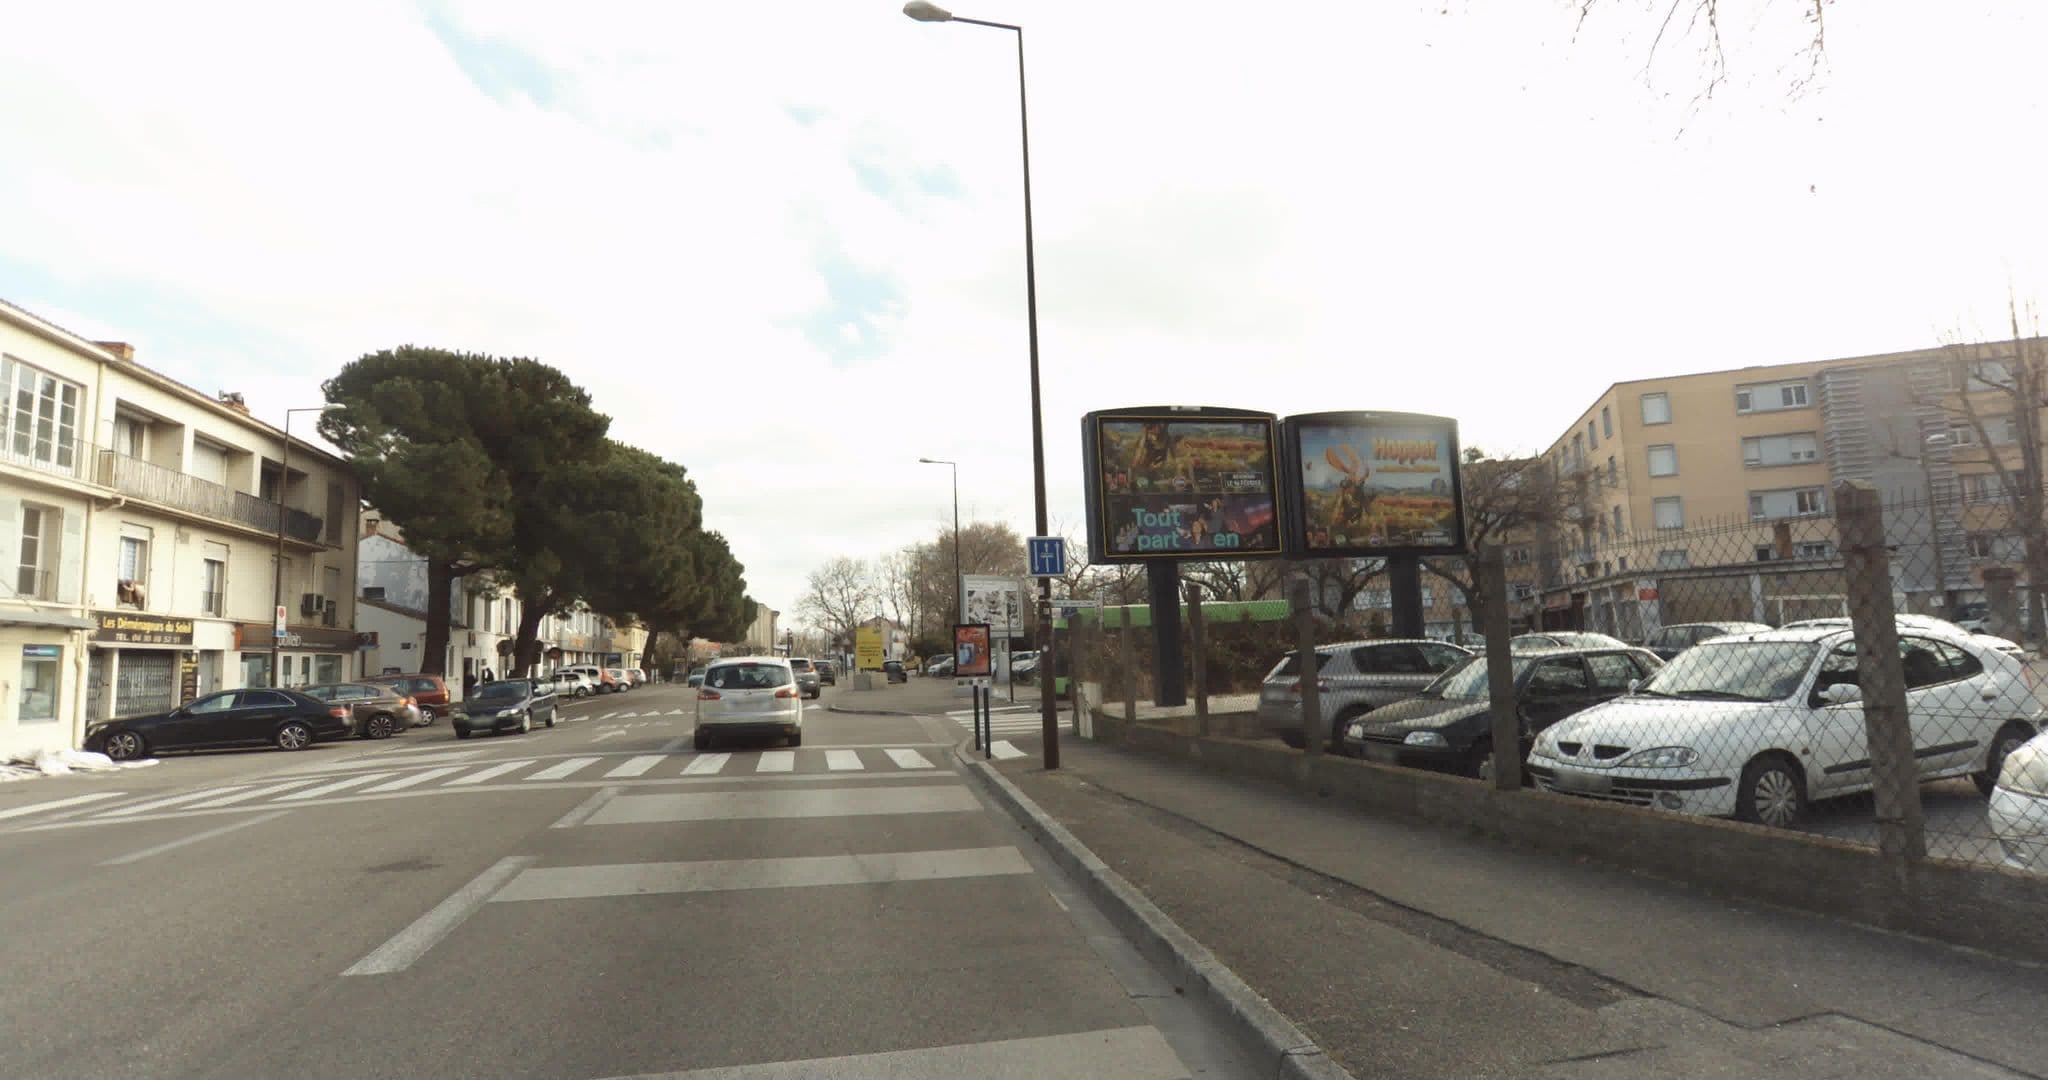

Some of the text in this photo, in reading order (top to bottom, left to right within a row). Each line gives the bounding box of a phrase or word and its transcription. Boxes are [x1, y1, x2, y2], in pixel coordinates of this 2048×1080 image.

[1131, 508, 1181, 527] Tout
[1137, 531, 1240, 551] part en
[103, 616, 116, 629] Les
[165, 621, 174, 632] du
